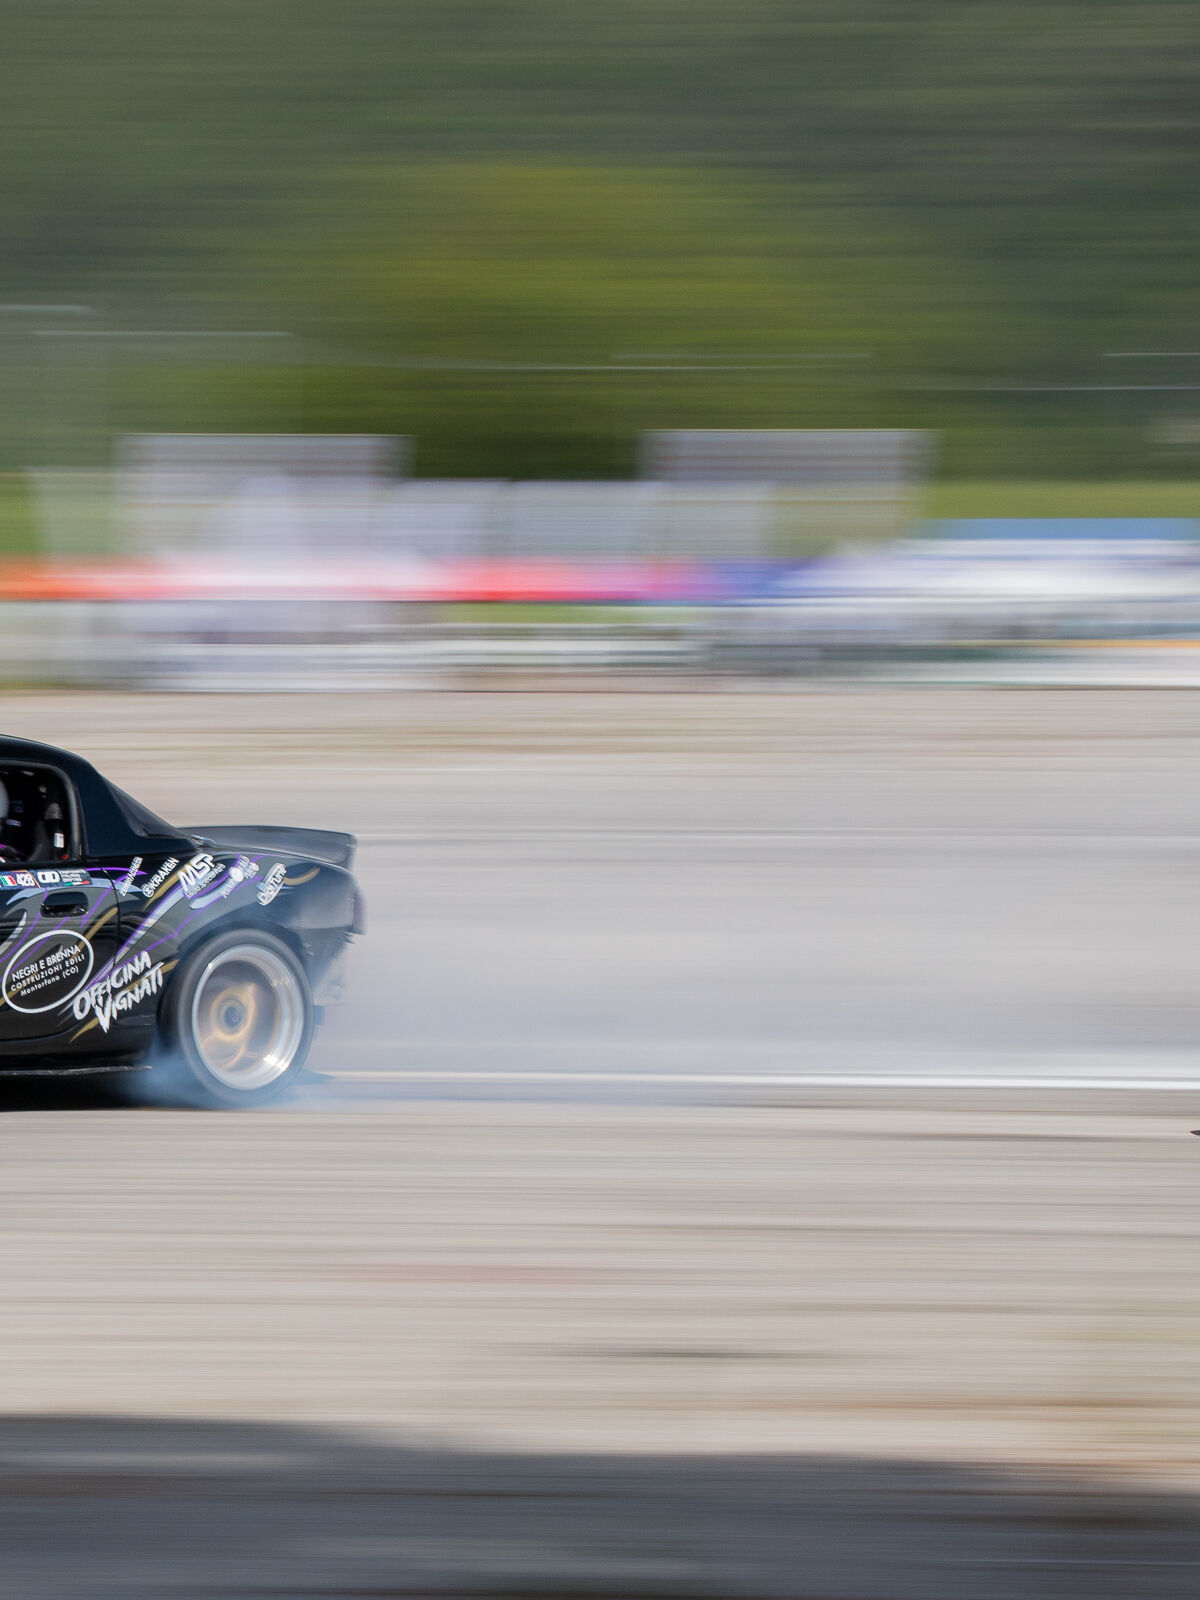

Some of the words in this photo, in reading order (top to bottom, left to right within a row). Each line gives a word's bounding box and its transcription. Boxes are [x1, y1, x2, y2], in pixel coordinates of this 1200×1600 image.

[16, 873, 36, 887] 428
[148, 857, 180, 891] KRAKEN
[10, 965, 63, 992] COSTRUZIONI
[65, 954, 85, 969] EDILI
[11, 962, 39, 982] NEGRI
[39, 960, 46, 971] E
[45, 945, 81, 966] BRENNA
[20, 975, 60, 997] Montorfano
[62, 966, 79, 980] (CO)
[73, 950, 152, 1021] OFFICINA
[94, 962, 165, 1034] VIGNATI
